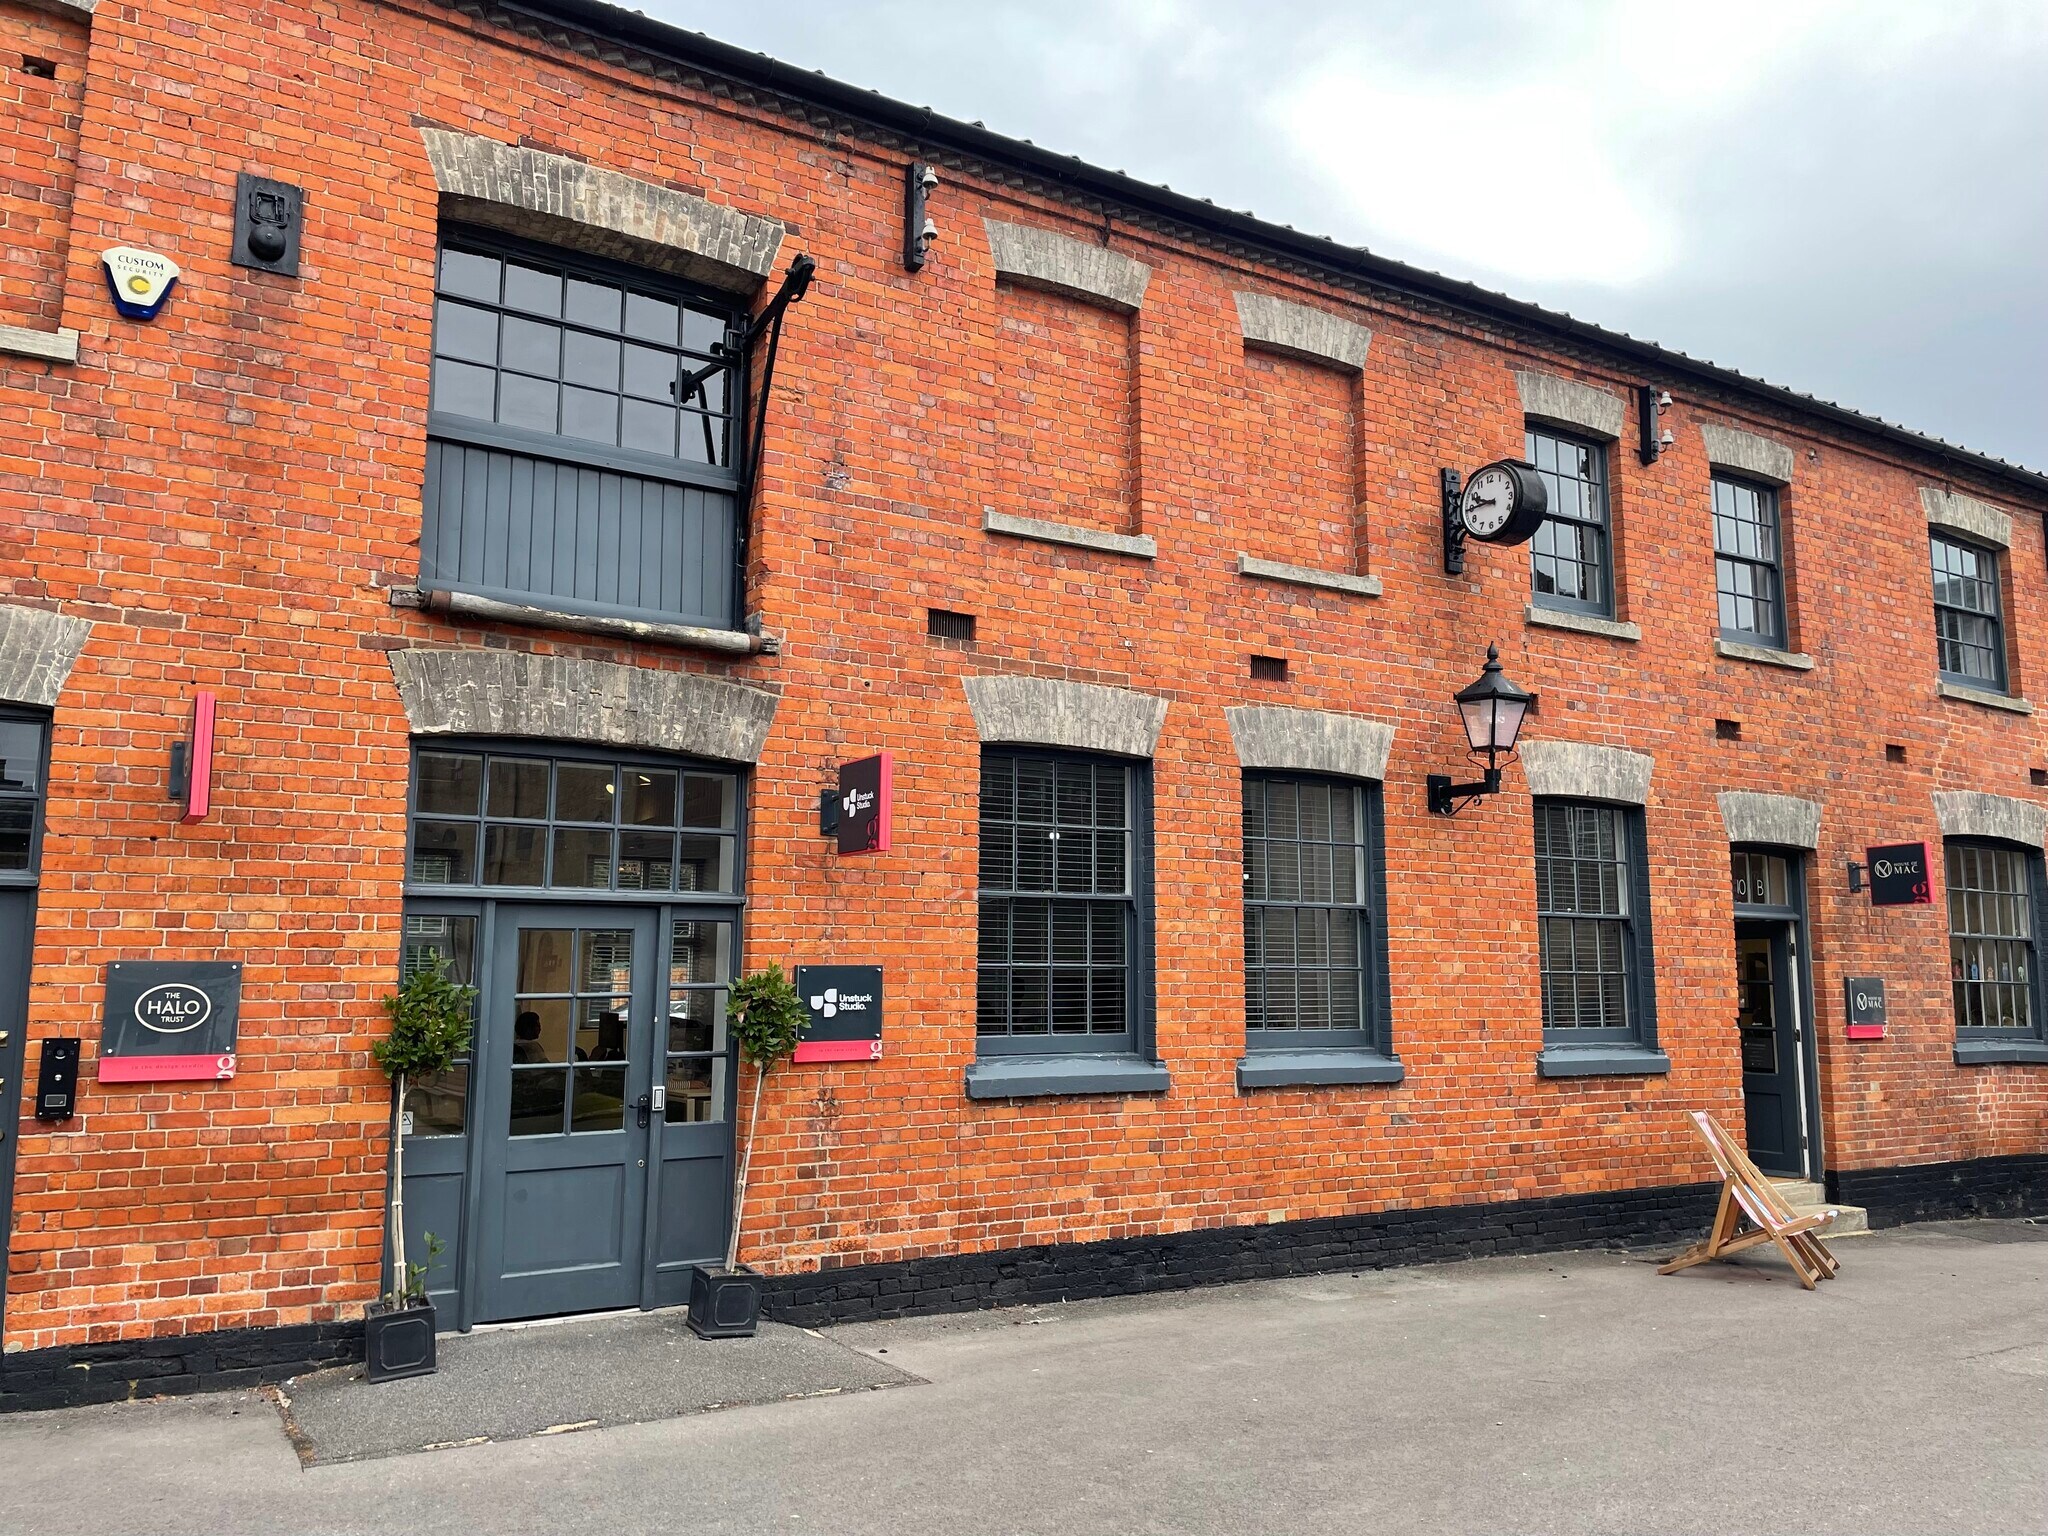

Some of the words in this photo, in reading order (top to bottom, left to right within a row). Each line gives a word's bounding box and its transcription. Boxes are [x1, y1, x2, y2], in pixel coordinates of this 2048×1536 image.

[118, 254, 164, 270] CUSTOM
[117, 264, 164, 277] SECURITY
[1486, 474, 1494, 484] 12
[1498, 474, 1502, 482] 1
[1477, 480, 1483, 490] 11
[1505, 481, 1510, 490] 2
[1508, 491, 1513, 500] 3
[1469, 504, 1474, 512] 9
[1506, 503, 1511, 512] 4
[1472, 514, 1477, 523] 8
[1498, 515, 1503, 524] 5
[1480, 521, 1485, 530] 7
[1489, 521, 1494, 529] 6
[856, 791, 874, 802] Unstuck
[1894, 865, 1920, 874] MAC
[1736, 879, 1746, 895] 10
[1756, 879, 1764, 896] B
[839, 993, 872, 1003] Unstuck
[147, 1000, 200, 1015] HALO
[839, 1002, 867, 1011] Studio.
[1868, 1000, 1883, 1009] MAC
